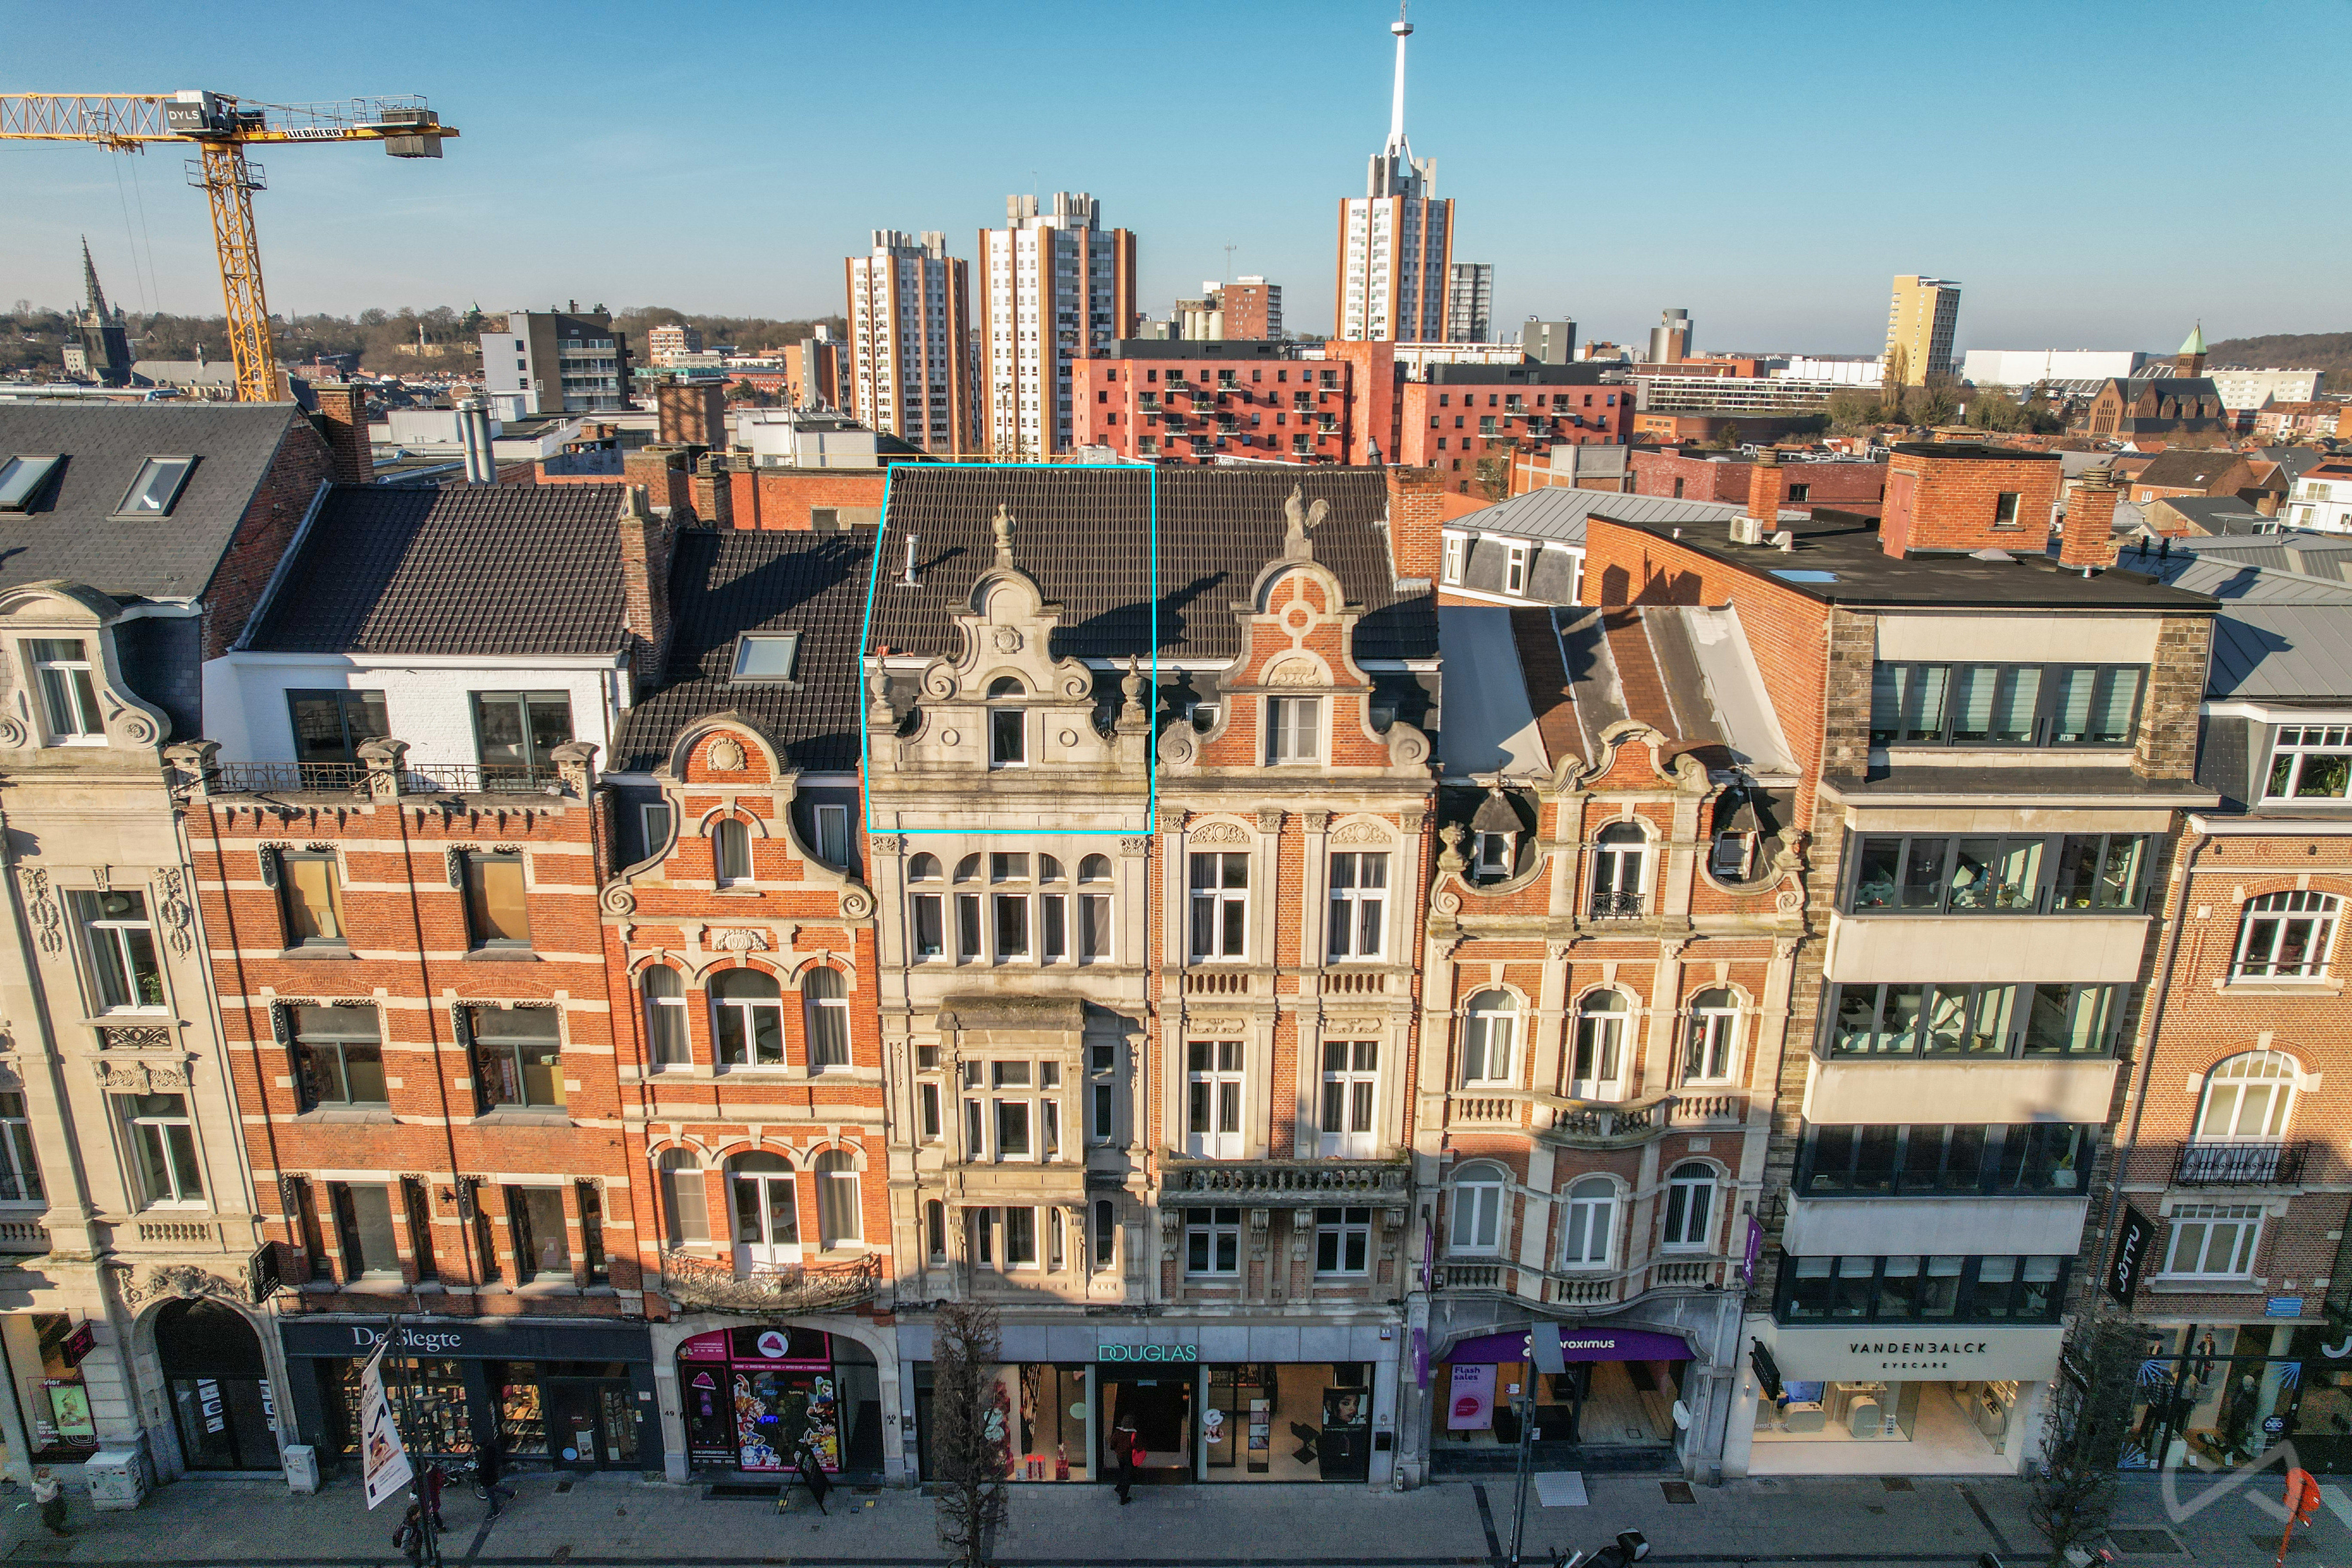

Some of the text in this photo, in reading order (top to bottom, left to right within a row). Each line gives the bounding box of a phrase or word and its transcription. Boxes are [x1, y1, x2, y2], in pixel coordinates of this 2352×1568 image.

[168, 109, 199, 121] DYLS
[288, 129, 341, 138] LIEBHERR
[262, 1283, 269, 1299] De
[351, 1327, 386, 1346] De
[1099, 1345, 1196, 1361] DOUGLAS
